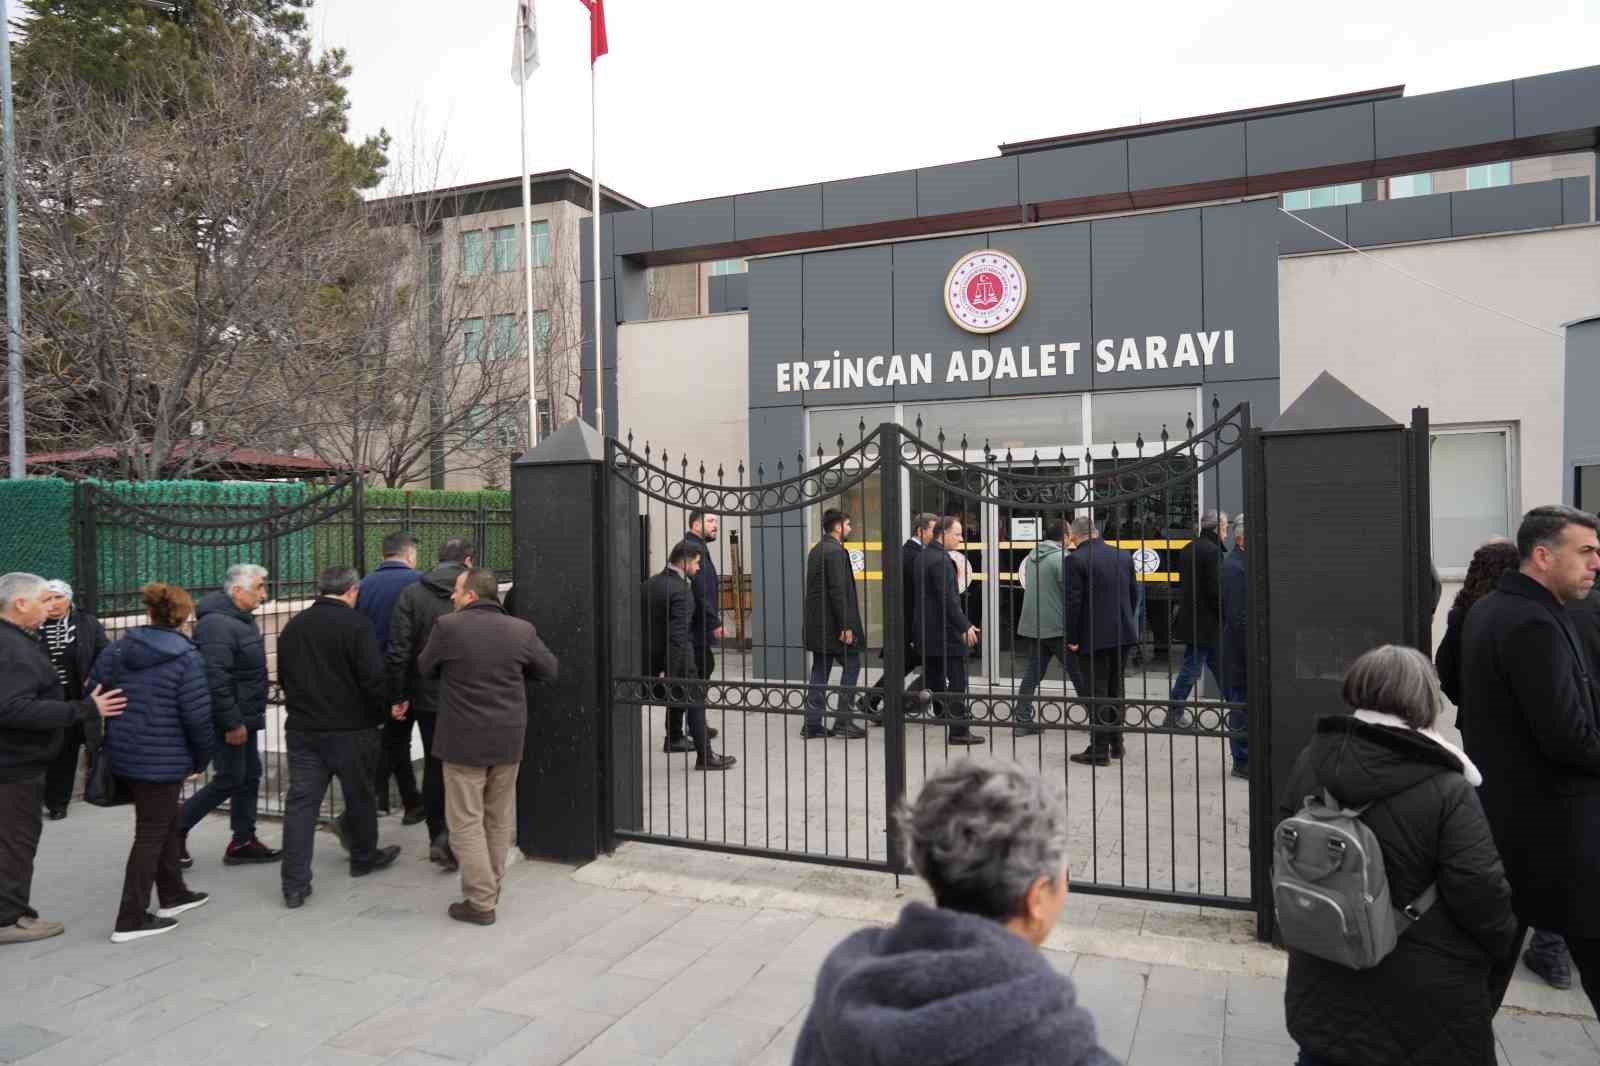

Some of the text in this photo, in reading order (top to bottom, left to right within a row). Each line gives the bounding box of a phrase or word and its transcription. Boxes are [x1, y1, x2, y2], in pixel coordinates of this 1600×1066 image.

[776, 330, 1235, 393] ERZİNCAN ADALET SARAYI
